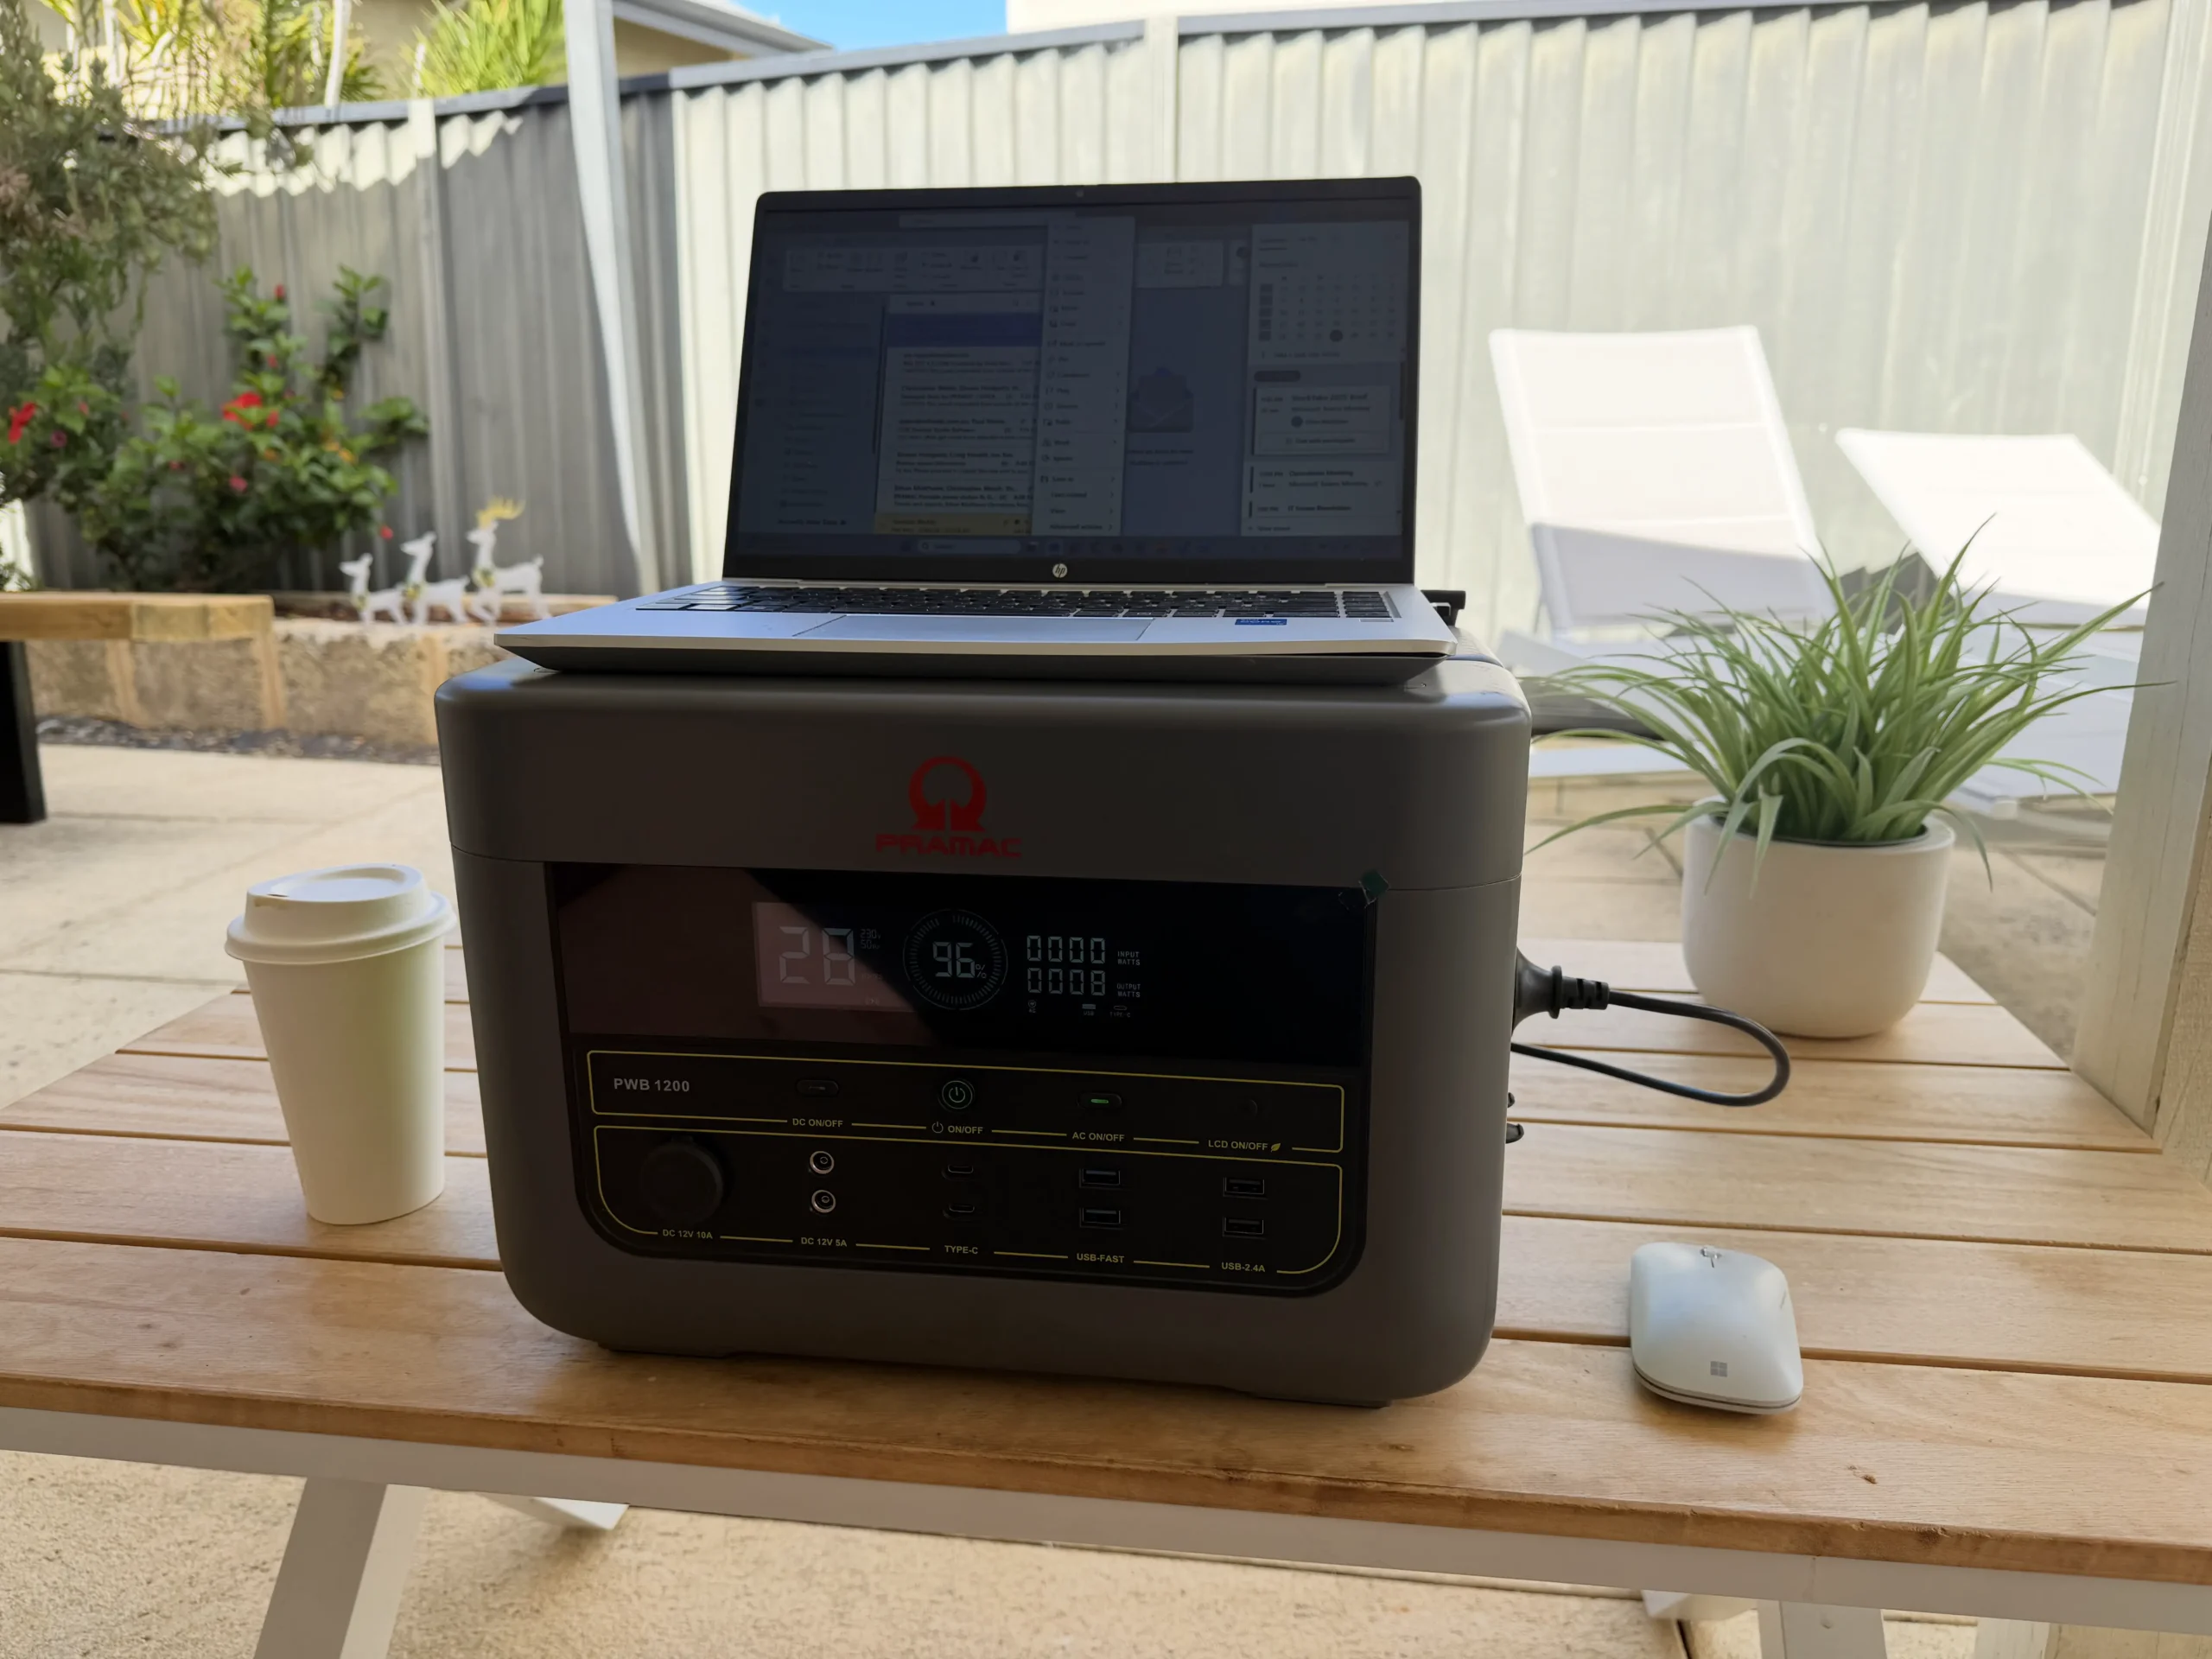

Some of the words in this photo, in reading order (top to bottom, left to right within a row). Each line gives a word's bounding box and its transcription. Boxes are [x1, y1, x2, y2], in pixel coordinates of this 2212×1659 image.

[1053, 563, 1068, 578] hp
[874, 832, 1023, 860] PRAMAC
[1026, 934, 1107, 964] 0000
[779, 925, 856, 987] 28
[1027, 967, 1107, 996] 0008
[613, 1077, 651, 1091] PWB
[654, 1079, 690, 1093] 1200
[791, 1117, 806, 1127] DC
[808, 1118, 843, 1128] ON/OFF
[947, 1124, 984, 1135] ON/OFF
[1071, 1131, 1087, 1141] AC
[1088, 1132, 1125, 1142] ON/OFF
[1207, 1139, 1229, 1149] LCD
[1230, 1141, 1268, 1151] ON/OFF
[662, 1229, 676, 1237] DC
[678, 1230, 695, 1239] 12V
[696, 1230, 714, 1240] 10A
[800, 1236, 814, 1246] DC
[817, 1237, 833, 1247] 12V
[835, 1238, 848, 1248] 5A
[944, 1244, 979, 1255] TYPE-C
[1076, 1252, 1125, 1264] USB-FAST
[1221, 1261, 1266, 1274] USB-2.4A
